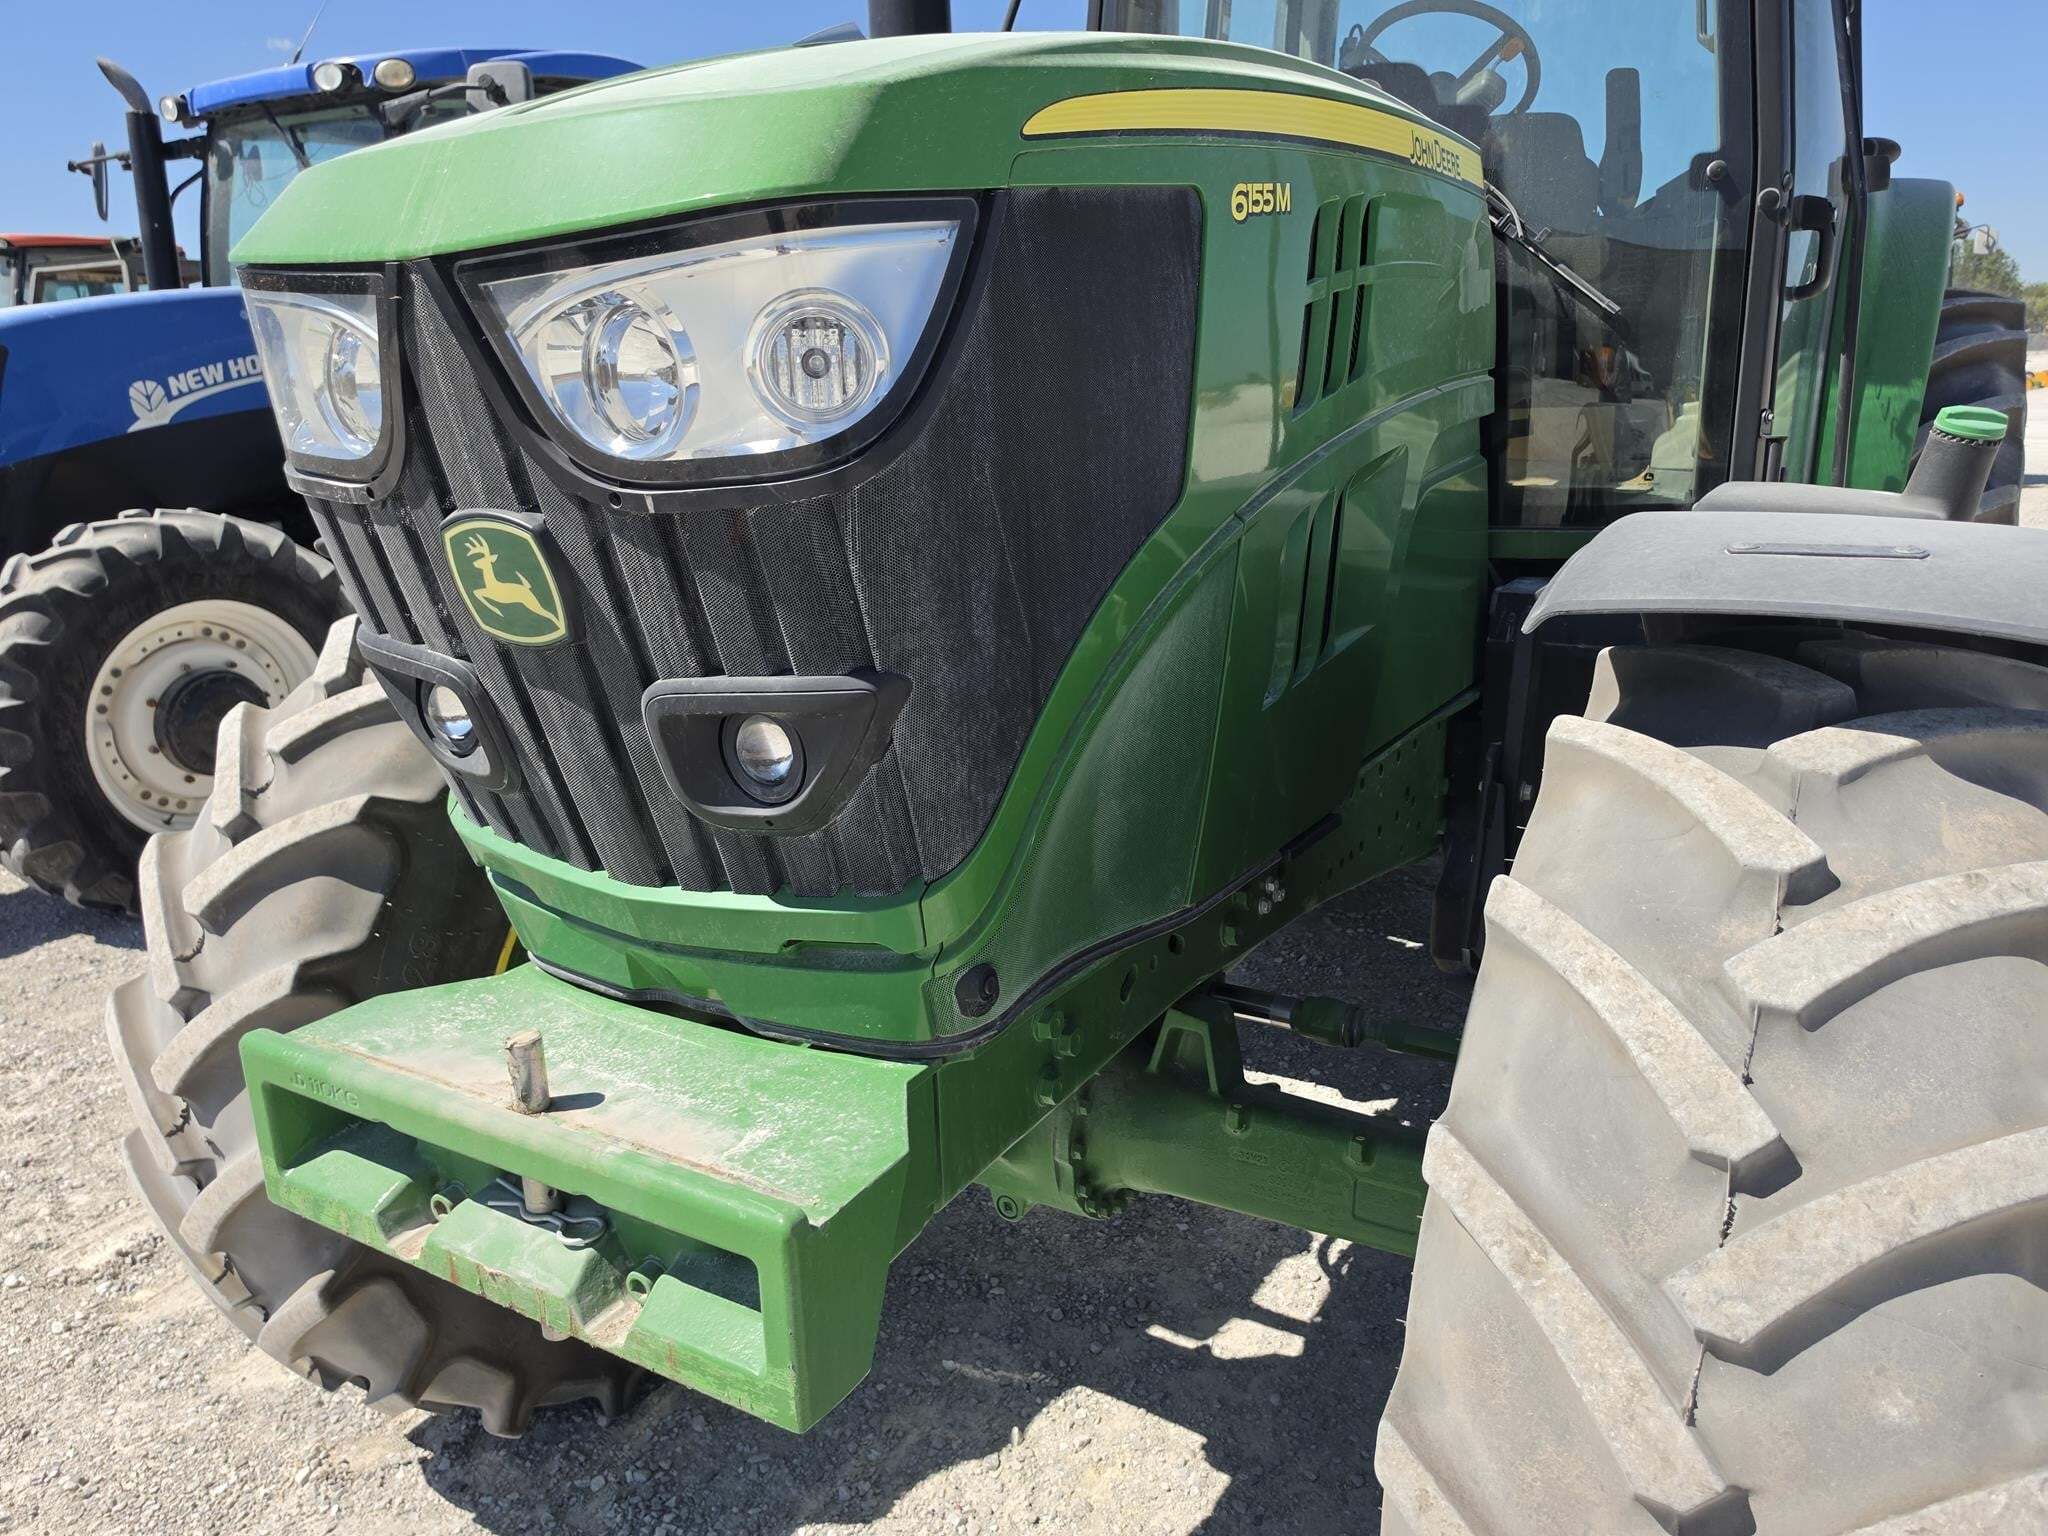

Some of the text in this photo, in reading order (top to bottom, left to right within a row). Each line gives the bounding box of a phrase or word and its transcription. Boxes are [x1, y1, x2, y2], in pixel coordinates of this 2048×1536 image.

[1410, 129, 1462, 179] JOHN DEERE
[1231, 182, 1292, 222] 6155M
[168, 362, 225, 396] NEW
